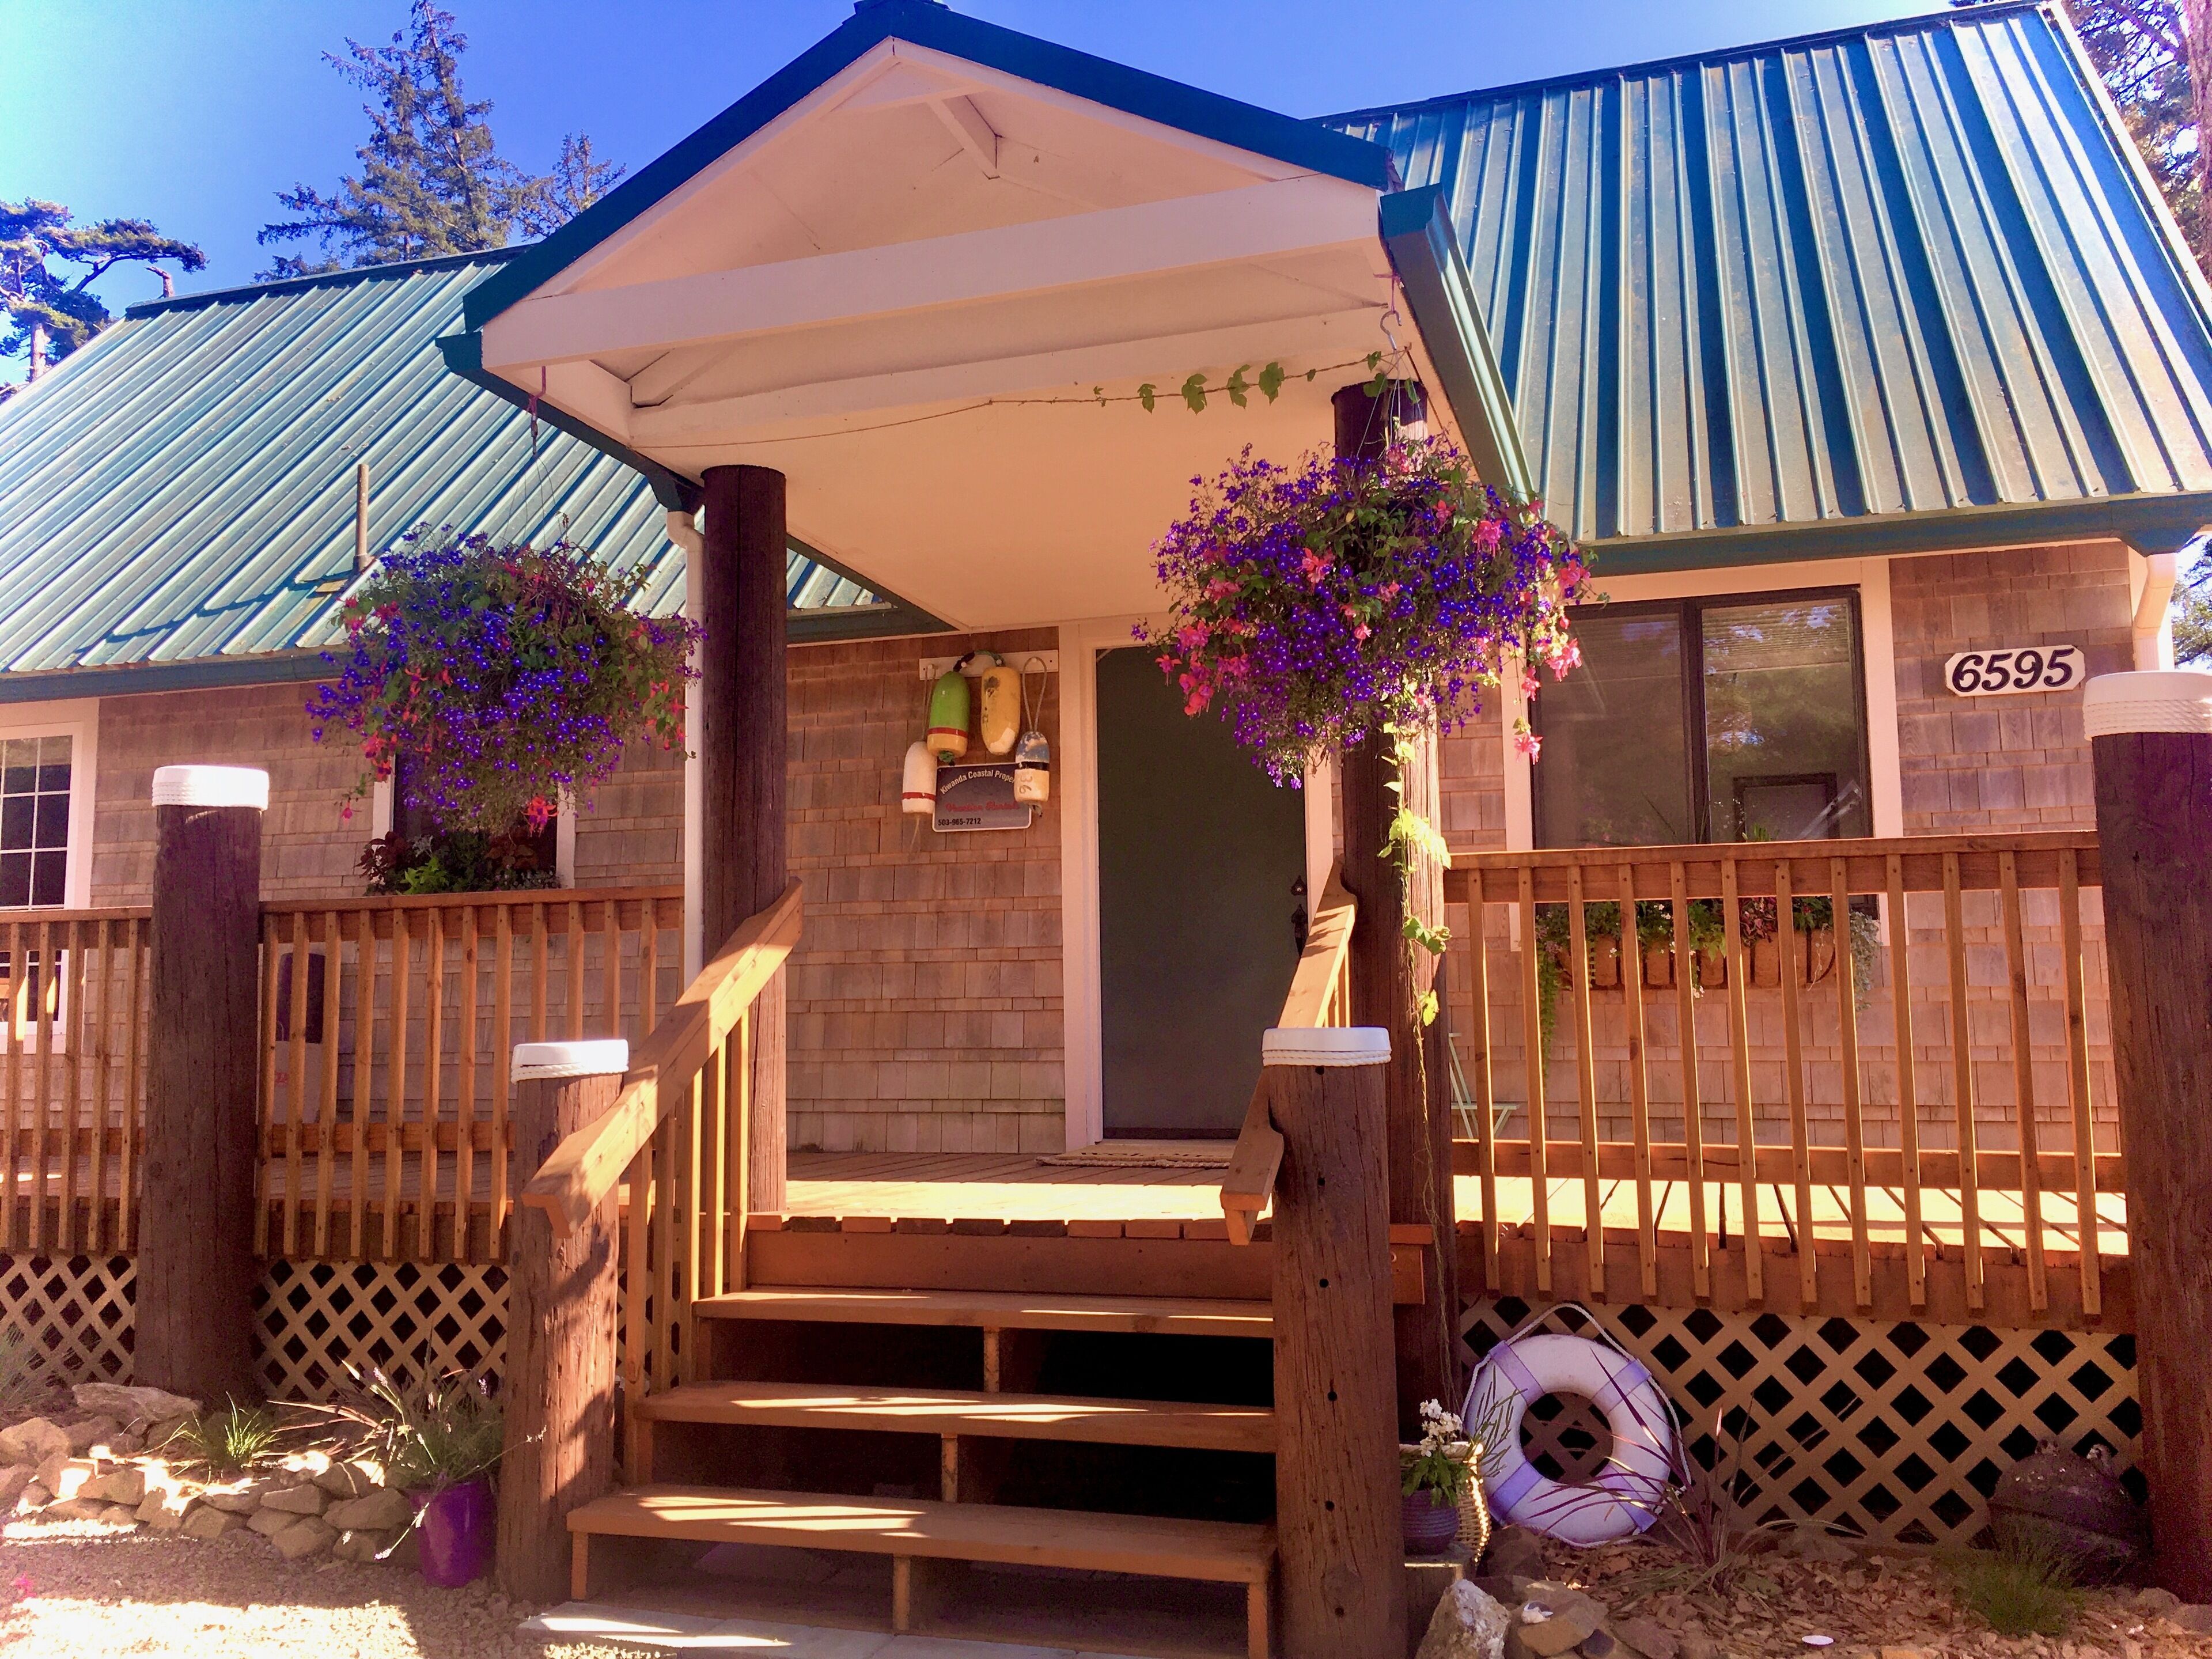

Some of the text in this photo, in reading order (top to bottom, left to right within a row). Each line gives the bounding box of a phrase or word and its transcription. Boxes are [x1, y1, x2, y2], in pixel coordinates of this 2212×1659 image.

[1952, 647, 2075, 693] 6595
[940, 774, 967, 794] Kiwanda
[968, 770, 993, 779] Coastal
